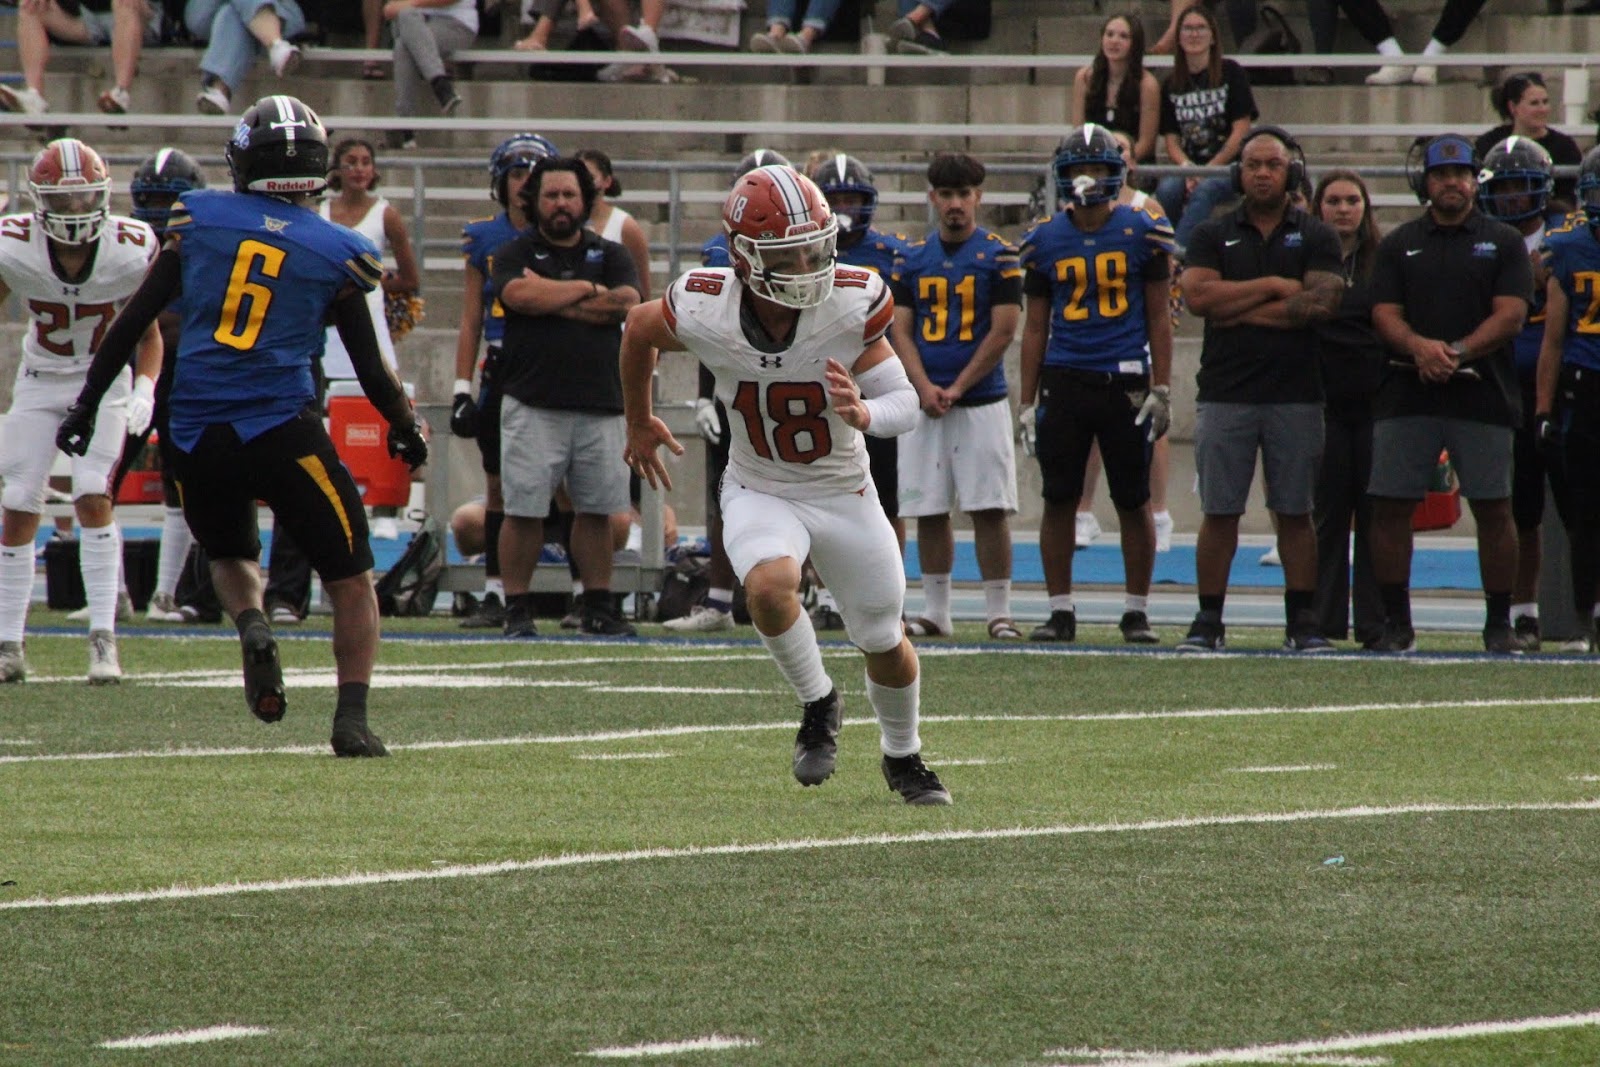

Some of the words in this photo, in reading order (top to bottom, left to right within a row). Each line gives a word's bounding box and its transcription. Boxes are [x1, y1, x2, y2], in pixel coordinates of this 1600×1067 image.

[266, 180, 315, 191] Riddell
[729, 194, 749, 223] 18
[1, 217, 31, 242] 27
[117, 221, 146, 247] 27
[791, 224, 816, 235] TRUST
[213, 239, 287, 350] 6
[685, 272, 726, 296] 18
[1055, 250, 1128, 321] 28
[918, 275, 975, 342] 31
[28, 299, 115, 356] 27
[732, 380, 833, 465] 18
